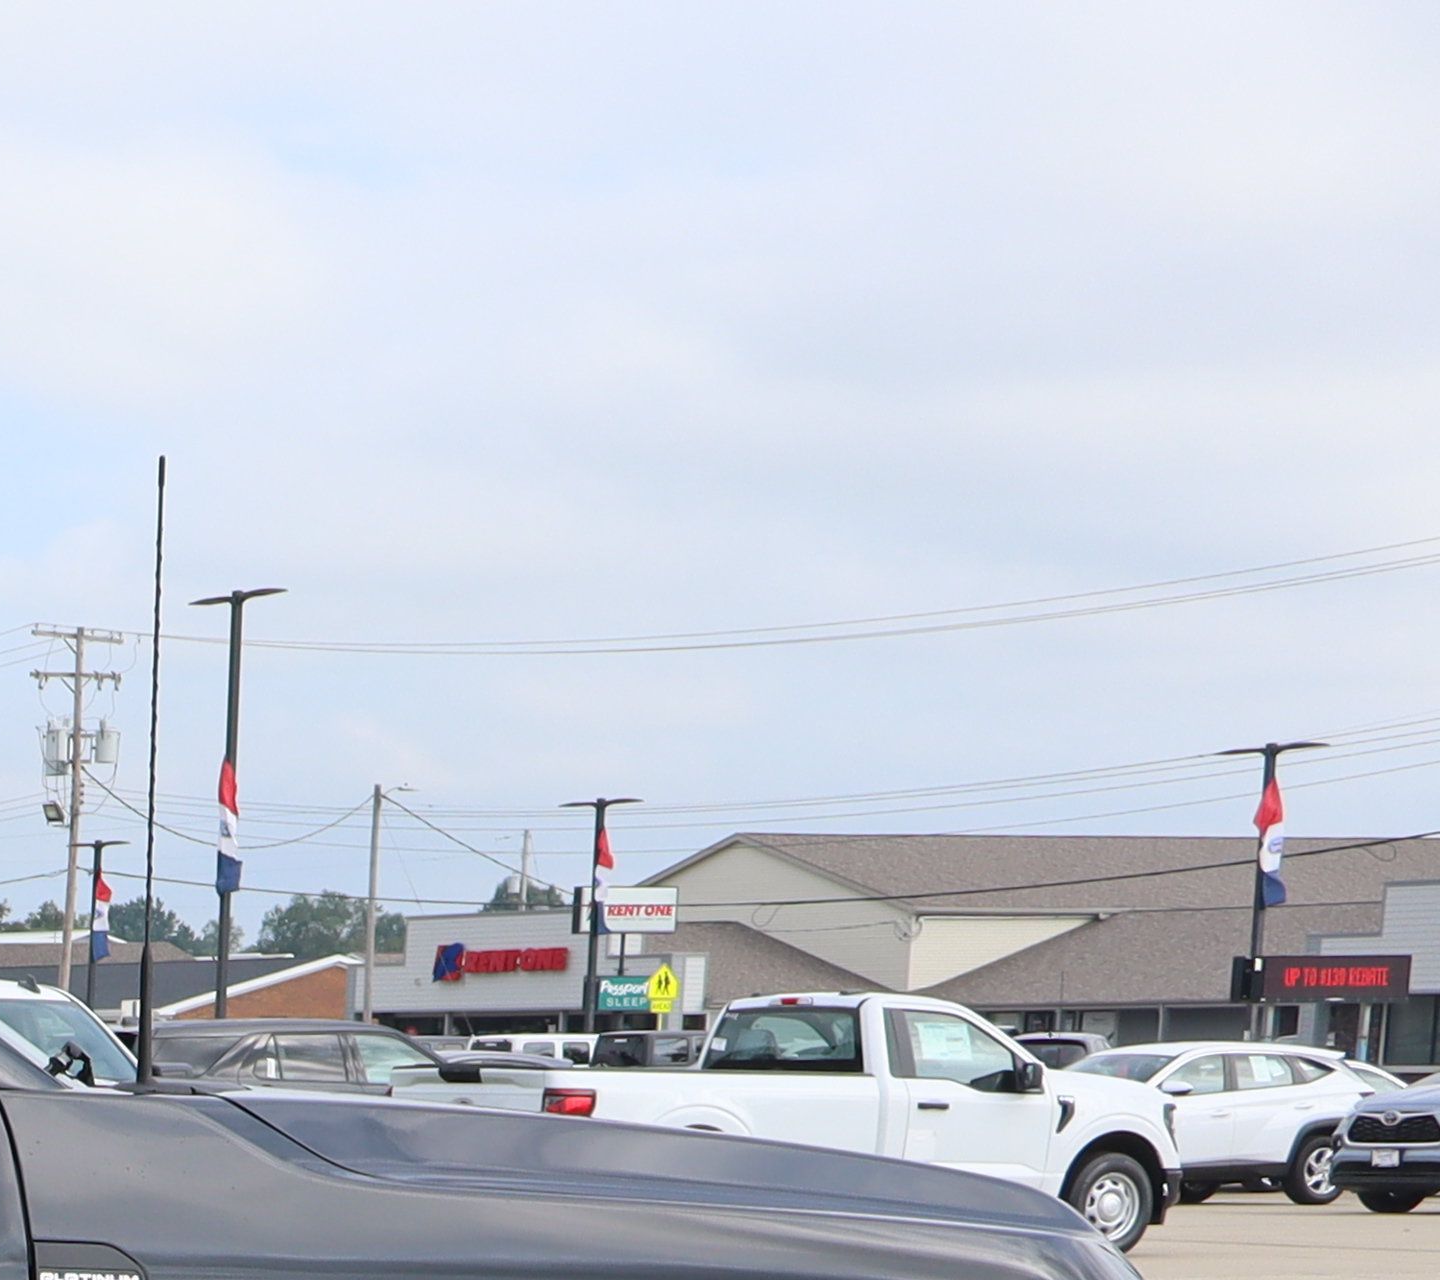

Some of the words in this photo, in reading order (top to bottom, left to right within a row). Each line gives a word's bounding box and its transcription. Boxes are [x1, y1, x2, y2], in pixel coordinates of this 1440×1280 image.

[607, 905, 641, 916] RENT
[644, 904, 673, 916] ONE
[464, 950, 521, 973] RENT
[522, 947, 567, 971] ONE
[1284, 967, 1301, 987] UP
[1303, 967, 1317, 987] TO
[606, 997, 648, 1007] SLEEP
